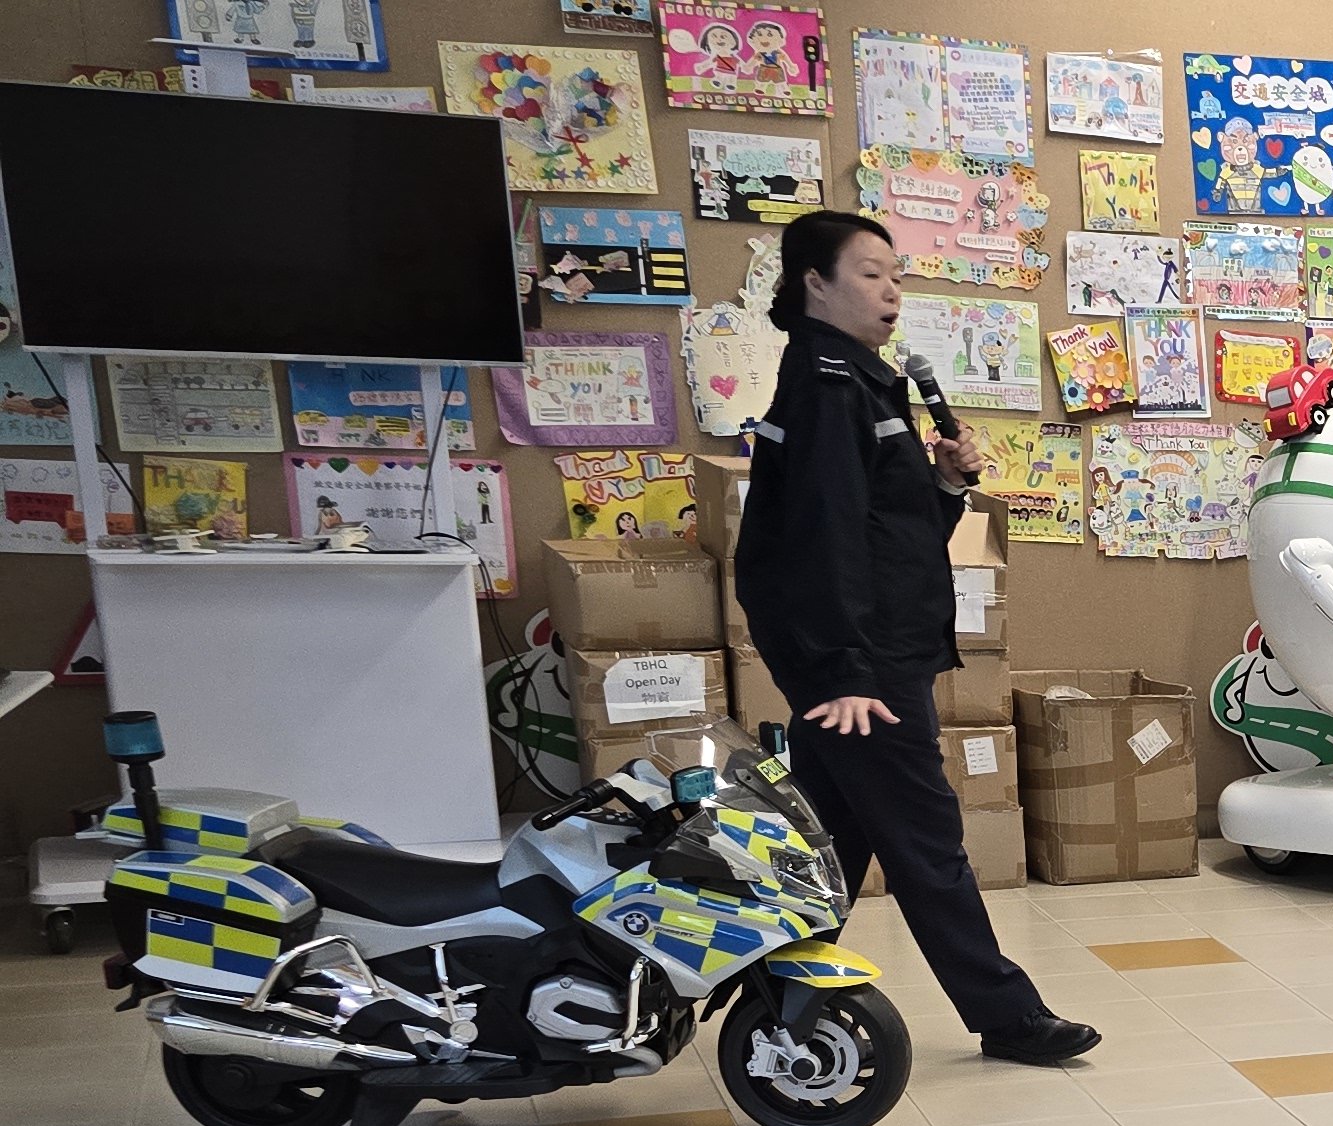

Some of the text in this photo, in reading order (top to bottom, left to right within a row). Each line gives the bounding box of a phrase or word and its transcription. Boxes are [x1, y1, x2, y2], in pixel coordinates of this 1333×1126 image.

[1233, 81, 1328, 104] 交通安全城
[1135, 317, 1191, 338] THANK
[1052, 326, 1118, 355] Thank You!
[1151, 338, 1186, 357] YOU
[550, 361, 613, 377] THANK
[569, 382, 603, 399] YOU
[984, 433, 1026, 465] ANK
[560, 452, 631, 478] Thank
[1004, 457, 1044, 489] YOU
[633, 659, 668, 672] TBHQ
[625, 675, 681, 690] Open Day
[641, 692, 670, 705] 物資
